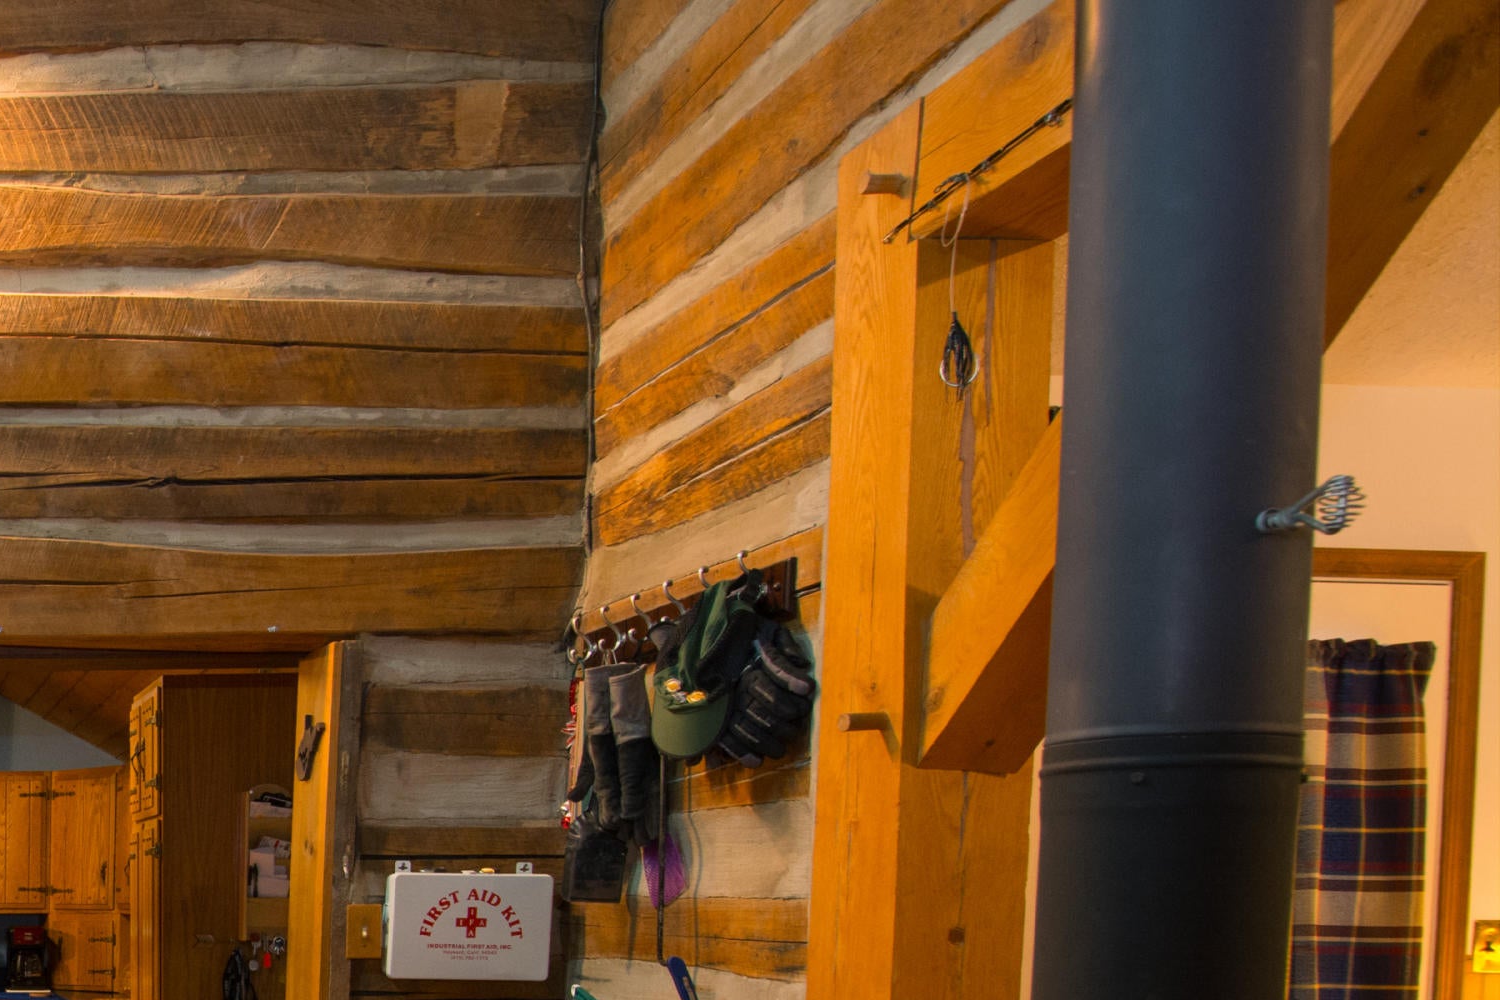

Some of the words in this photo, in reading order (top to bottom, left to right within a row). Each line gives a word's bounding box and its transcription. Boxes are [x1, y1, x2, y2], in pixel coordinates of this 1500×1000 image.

[420, 890, 460, 937] FIRST
[467, 888, 502, 907] AID
[501, 905, 523, 939] KIT
